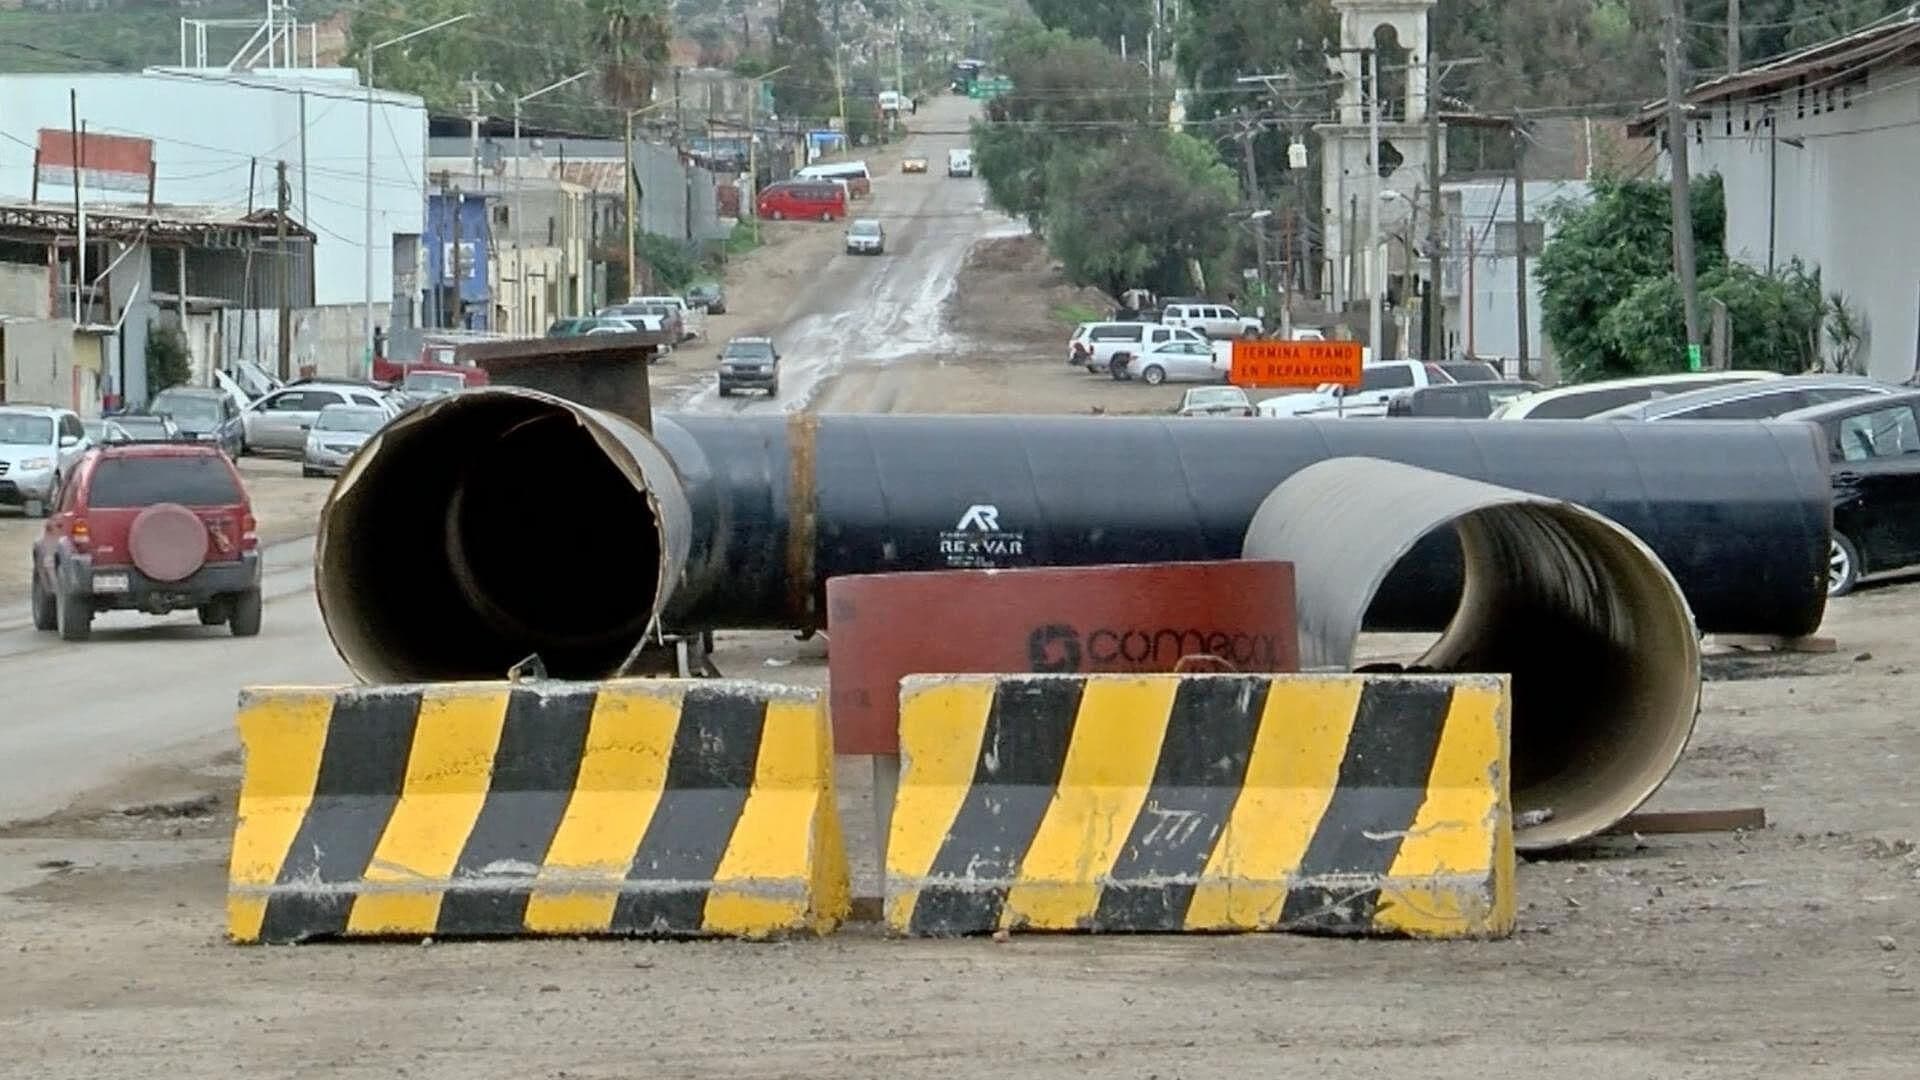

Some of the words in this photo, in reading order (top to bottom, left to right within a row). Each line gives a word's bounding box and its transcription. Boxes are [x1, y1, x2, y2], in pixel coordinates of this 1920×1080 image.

[1242, 346, 1300, 359] TERMINA
[1310, 346, 1353, 359] TRAMO
[1242, 364, 1259, 377] EN
